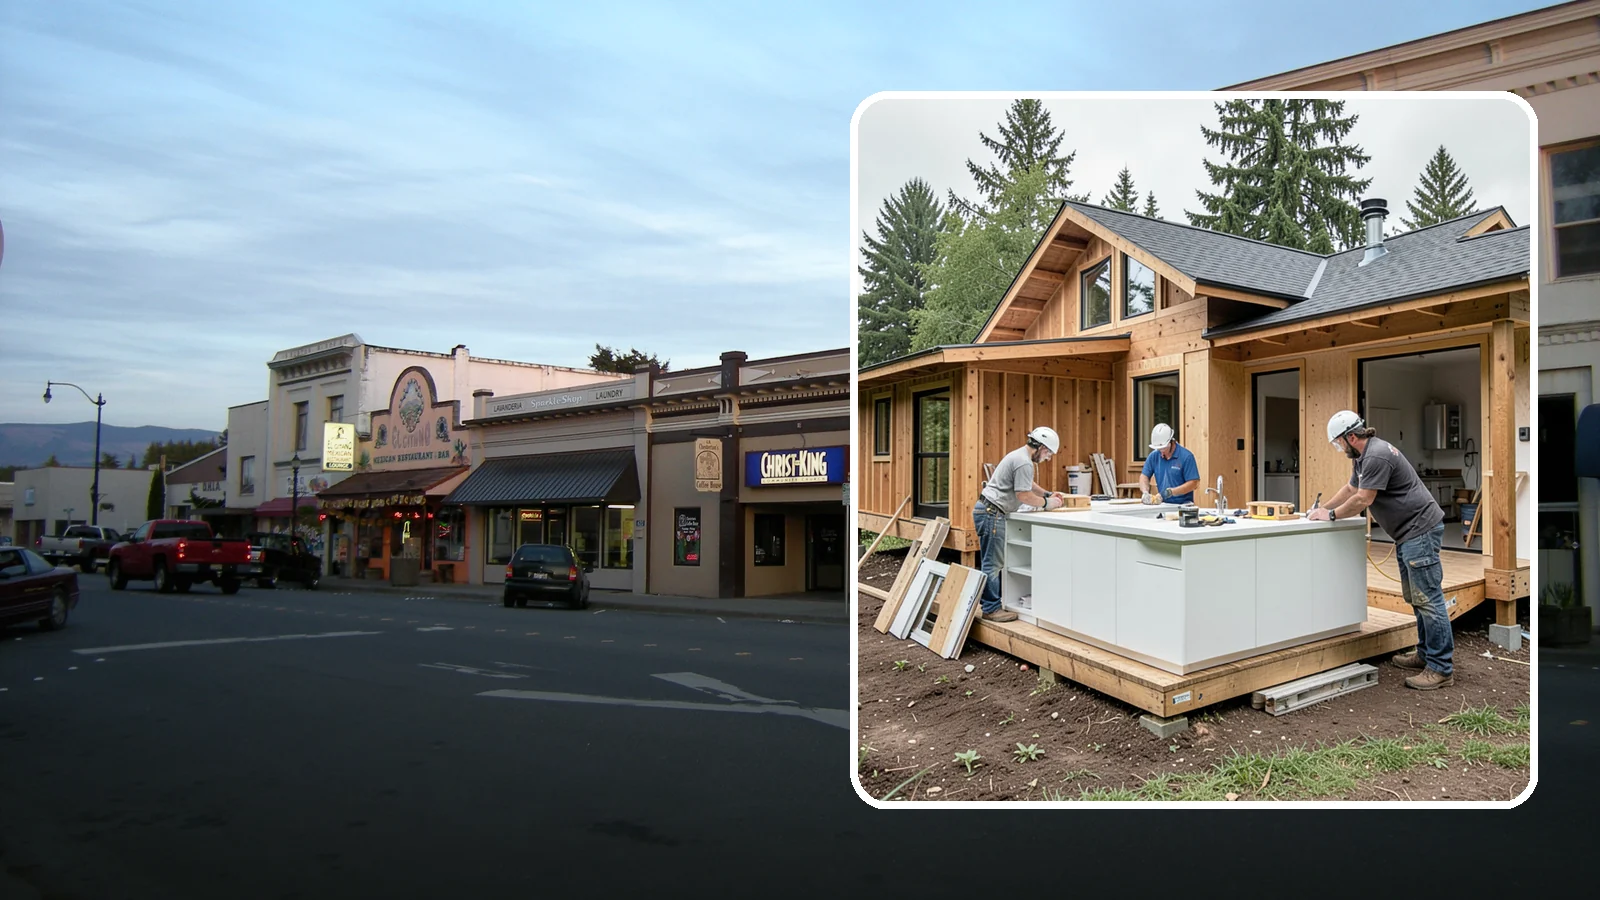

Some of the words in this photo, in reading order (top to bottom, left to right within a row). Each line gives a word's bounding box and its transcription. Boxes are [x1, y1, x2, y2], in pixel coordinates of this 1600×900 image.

[595, 389, 624, 400] LAUNDRY
[493, 402, 523, 412] LAVANDERIA
[530, 397, 560, 409] Sparkle
[561, 394, 582, 405] Shop
[397, 451, 433, 462] RESTAURANT
[438, 450, 450, 459] BAR
